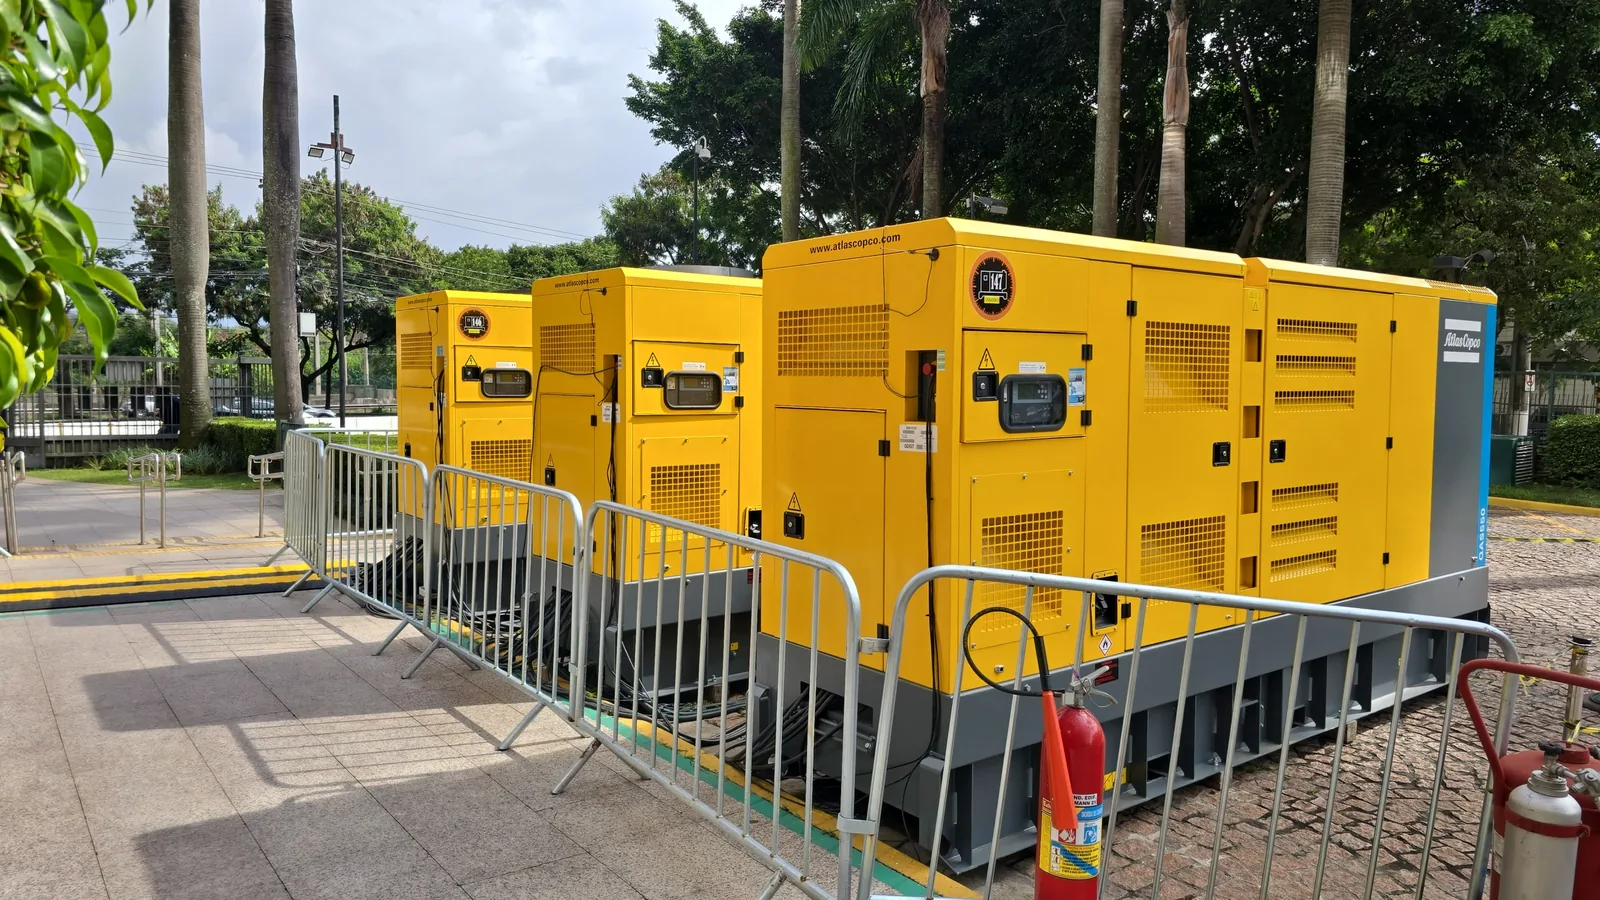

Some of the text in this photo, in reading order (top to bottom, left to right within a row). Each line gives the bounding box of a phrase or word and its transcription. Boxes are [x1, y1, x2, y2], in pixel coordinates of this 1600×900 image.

[809, 234, 901, 254] www.atlascopco.com
[990, 273, 1003, 290] 147
[472, 317, 482, 327] 146
[1478, 508, 1486, 561] QAS550
